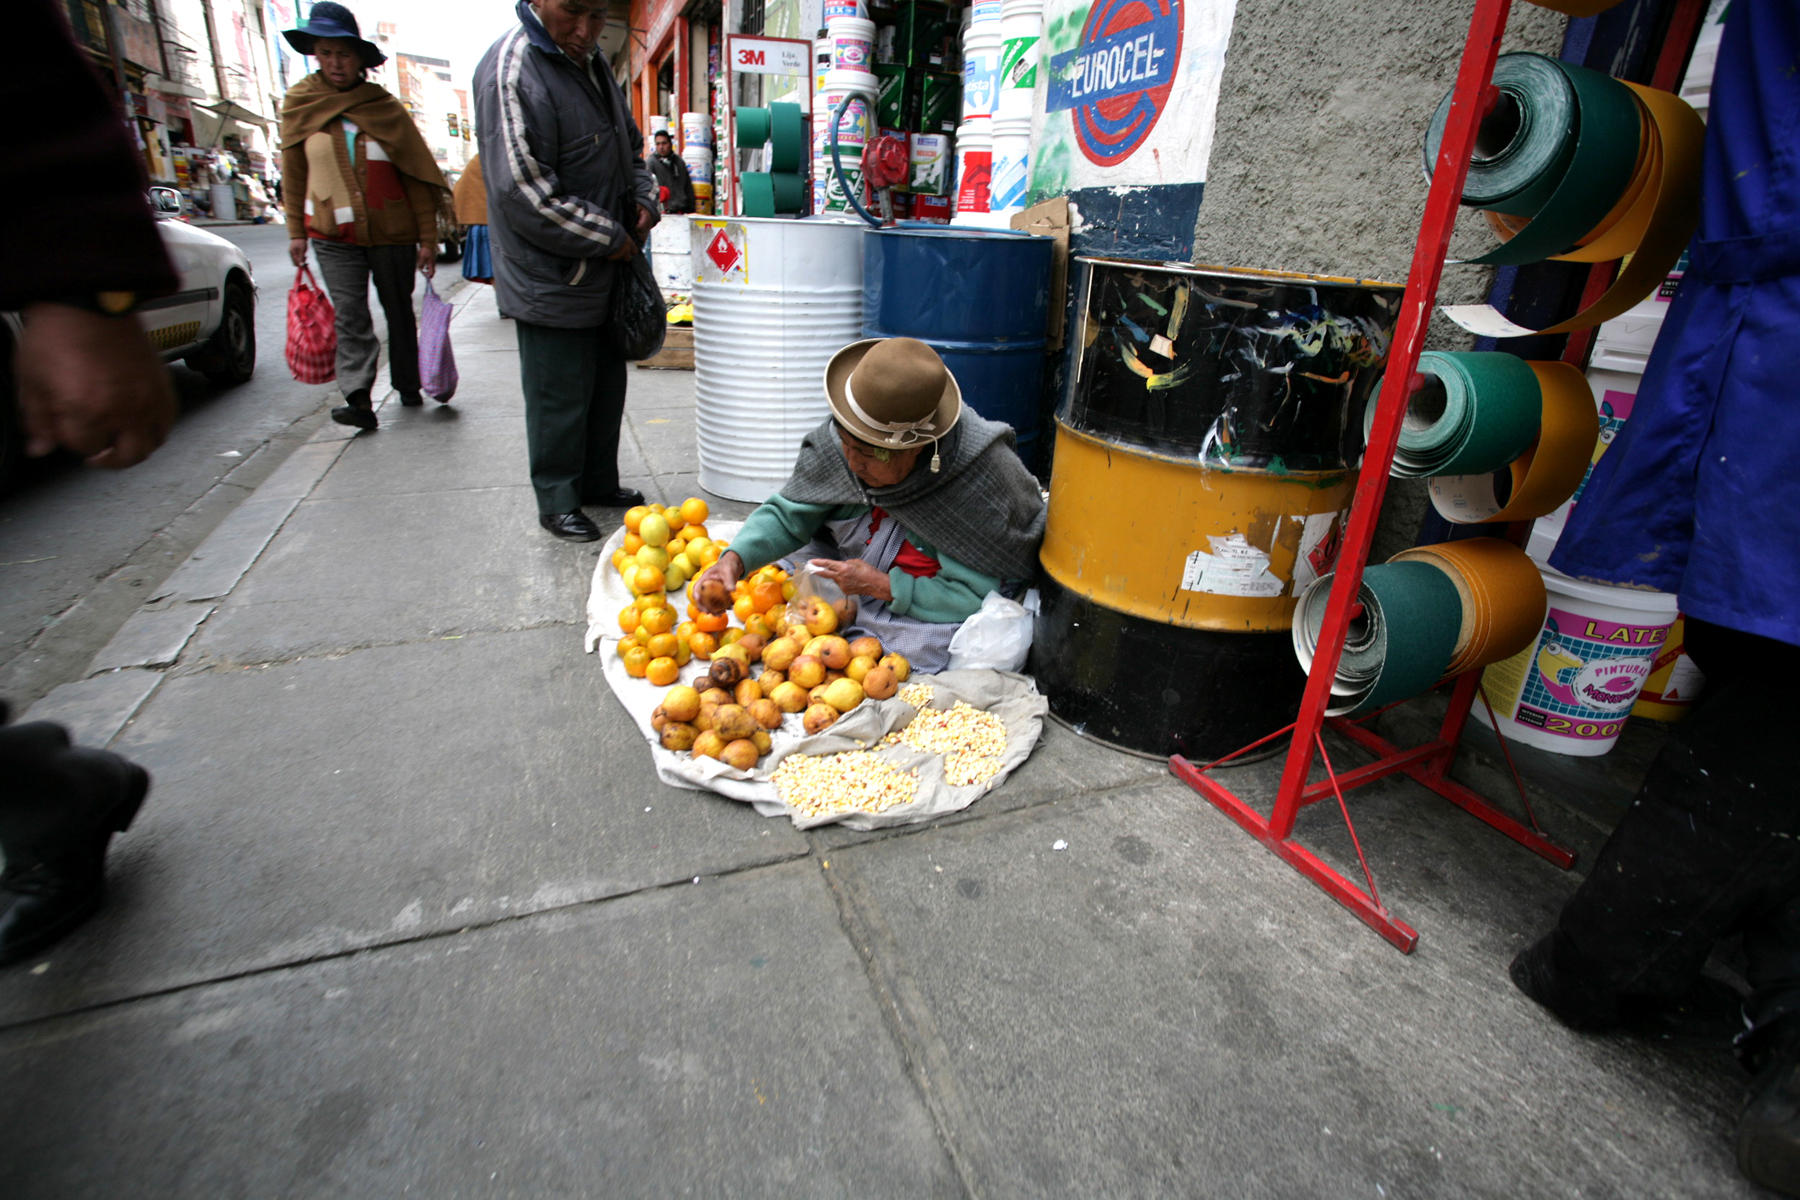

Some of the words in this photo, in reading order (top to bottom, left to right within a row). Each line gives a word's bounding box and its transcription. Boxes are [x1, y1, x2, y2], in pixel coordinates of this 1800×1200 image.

[738, 49, 765, 66] 3M
[1071, 32, 1159, 98] EUROCEL
[1545, 717, 1622, 738] 200
